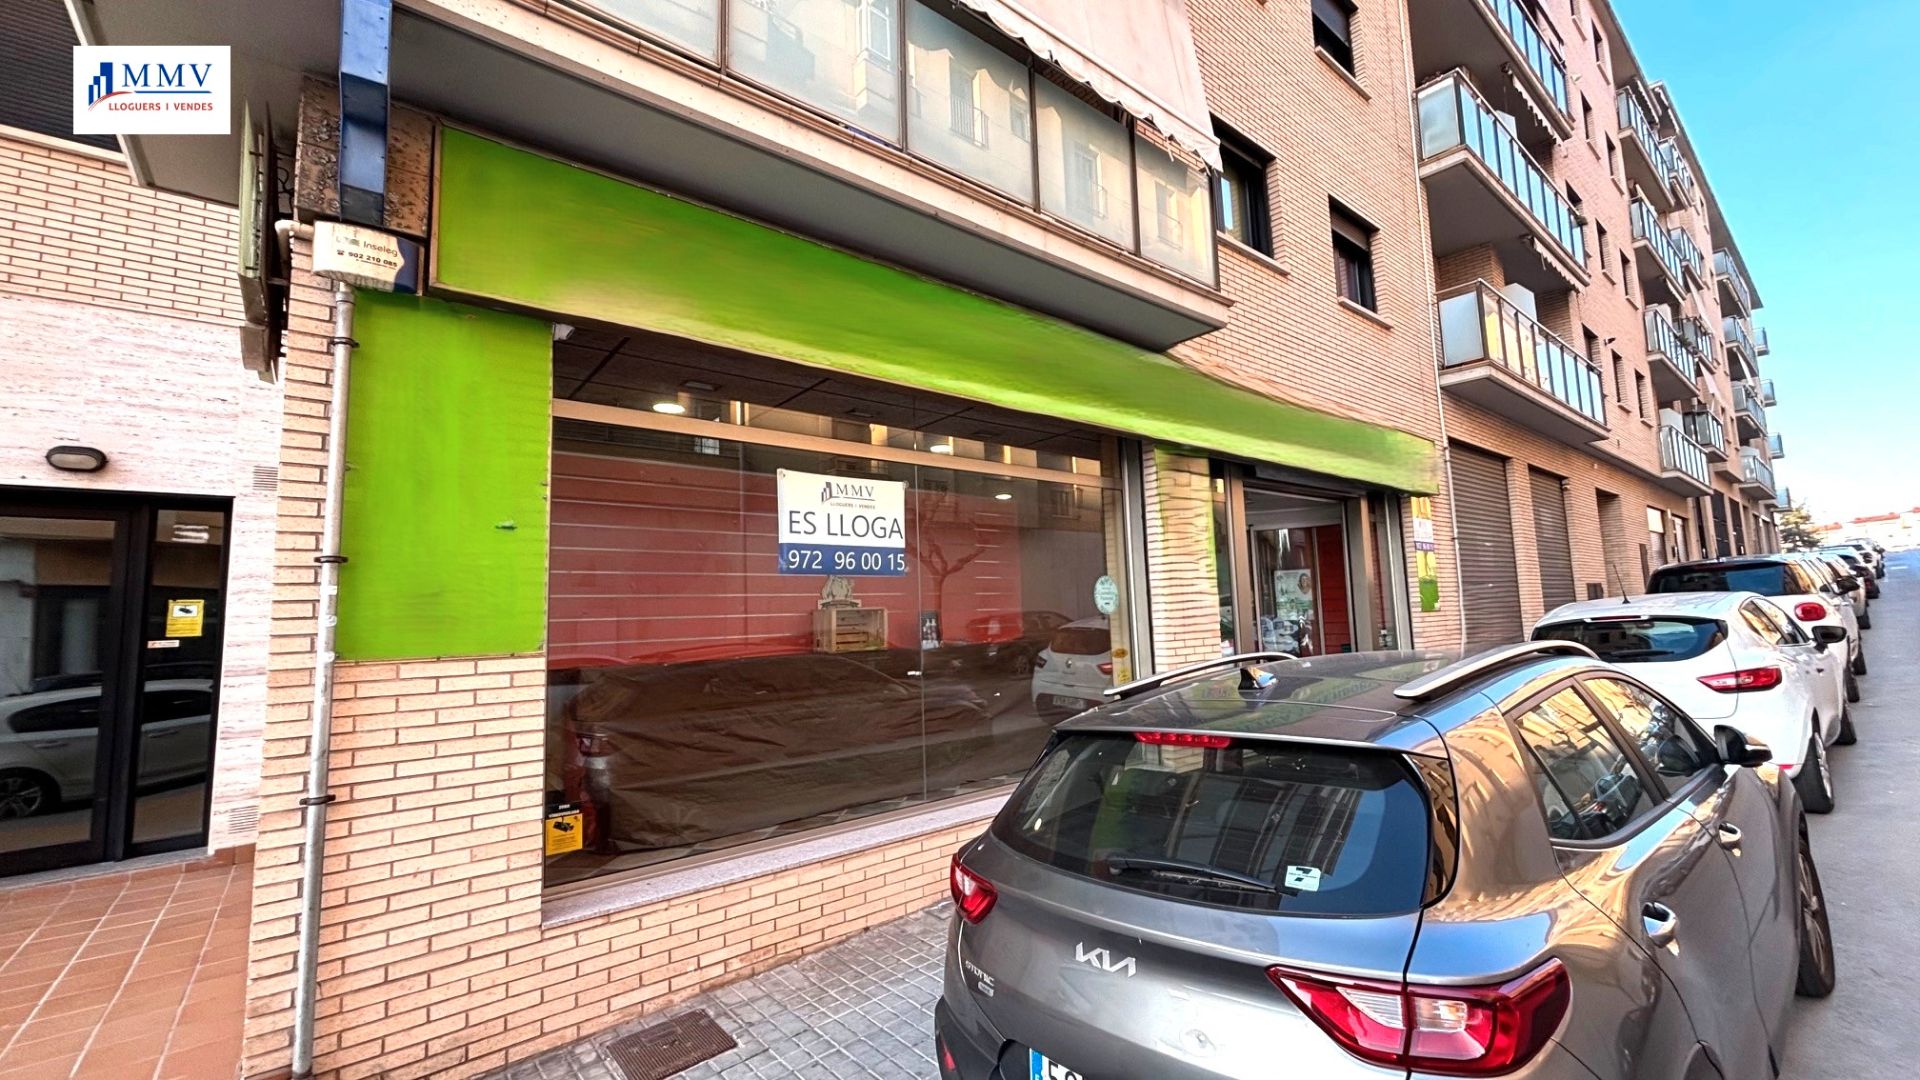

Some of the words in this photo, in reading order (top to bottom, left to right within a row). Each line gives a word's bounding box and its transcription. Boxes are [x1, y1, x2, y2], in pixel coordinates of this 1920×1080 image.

[366, 255, 381, 263] 210
[836, 482, 874, 498] MMV
[789, 510, 817, 535] ES
[826, 513, 904, 540] LLOGA
[788, 549, 823, 569] 972
[834, 551, 856, 570] 96
[861, 552, 881, 571] 00
[887, 553, 905, 571] 15
[1075, 941, 1137, 978] KIA
